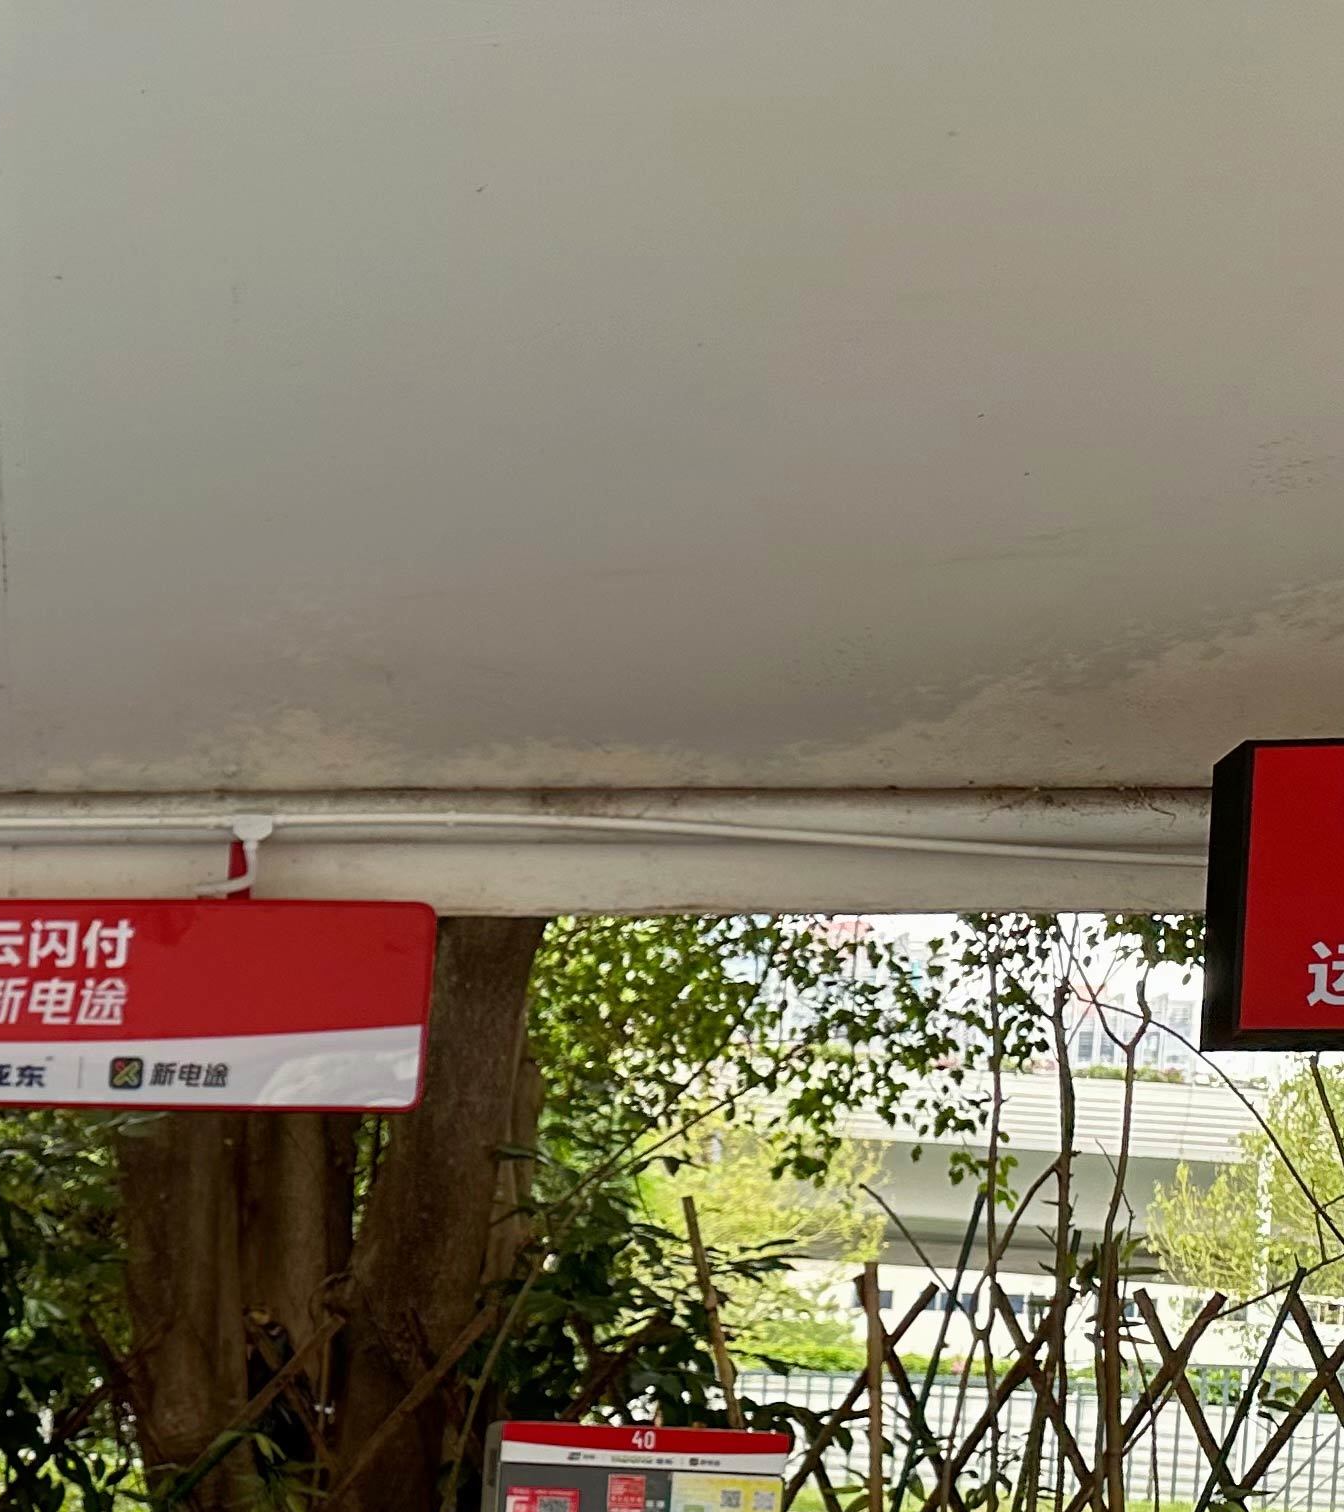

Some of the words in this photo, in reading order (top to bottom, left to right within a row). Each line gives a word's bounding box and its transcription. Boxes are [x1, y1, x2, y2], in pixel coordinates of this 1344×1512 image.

[148, 1062, 229, 1088] 新电途
[631, 1430, 657, 1450] 40
